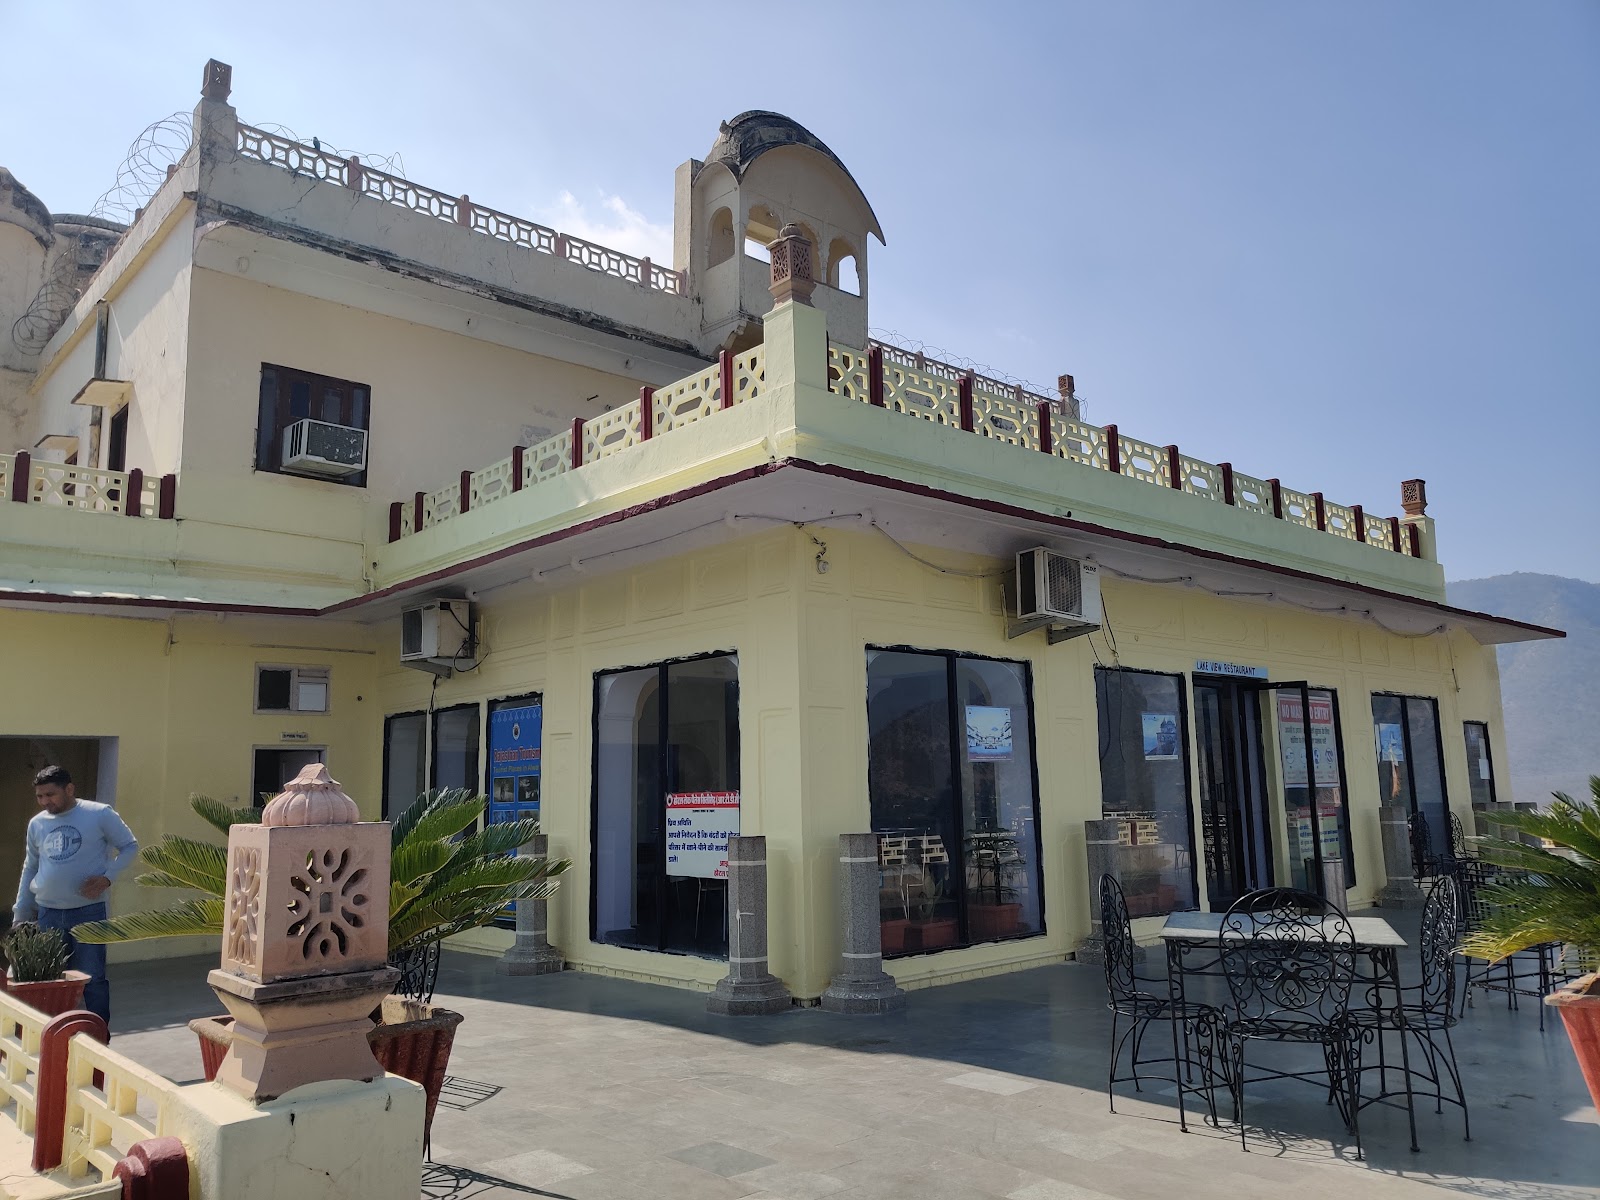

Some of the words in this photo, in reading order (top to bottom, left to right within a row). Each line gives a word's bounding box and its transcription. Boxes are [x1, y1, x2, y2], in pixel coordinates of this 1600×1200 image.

[1196, 661, 1208, 671] LAKE
[1210, 662, 1222, 672] VIEW
[1223, 663, 1256, 676] RESTAURANT
[1282, 704, 1290, 719] NO
[1290, 705, 1302, 720] MAS
[1313, 706, 1330, 721] ENTRY
[494, 748, 518, 766] Rajasthan
[519, 746, 540, 761] Tourism
[668, 830, 681, 838] आपसे
[681, 829, 697, 839] निवेदन
[697, 830, 701, 839] है
[701, 829, 709, 838] कि
[720, 830, 727, 839] को
